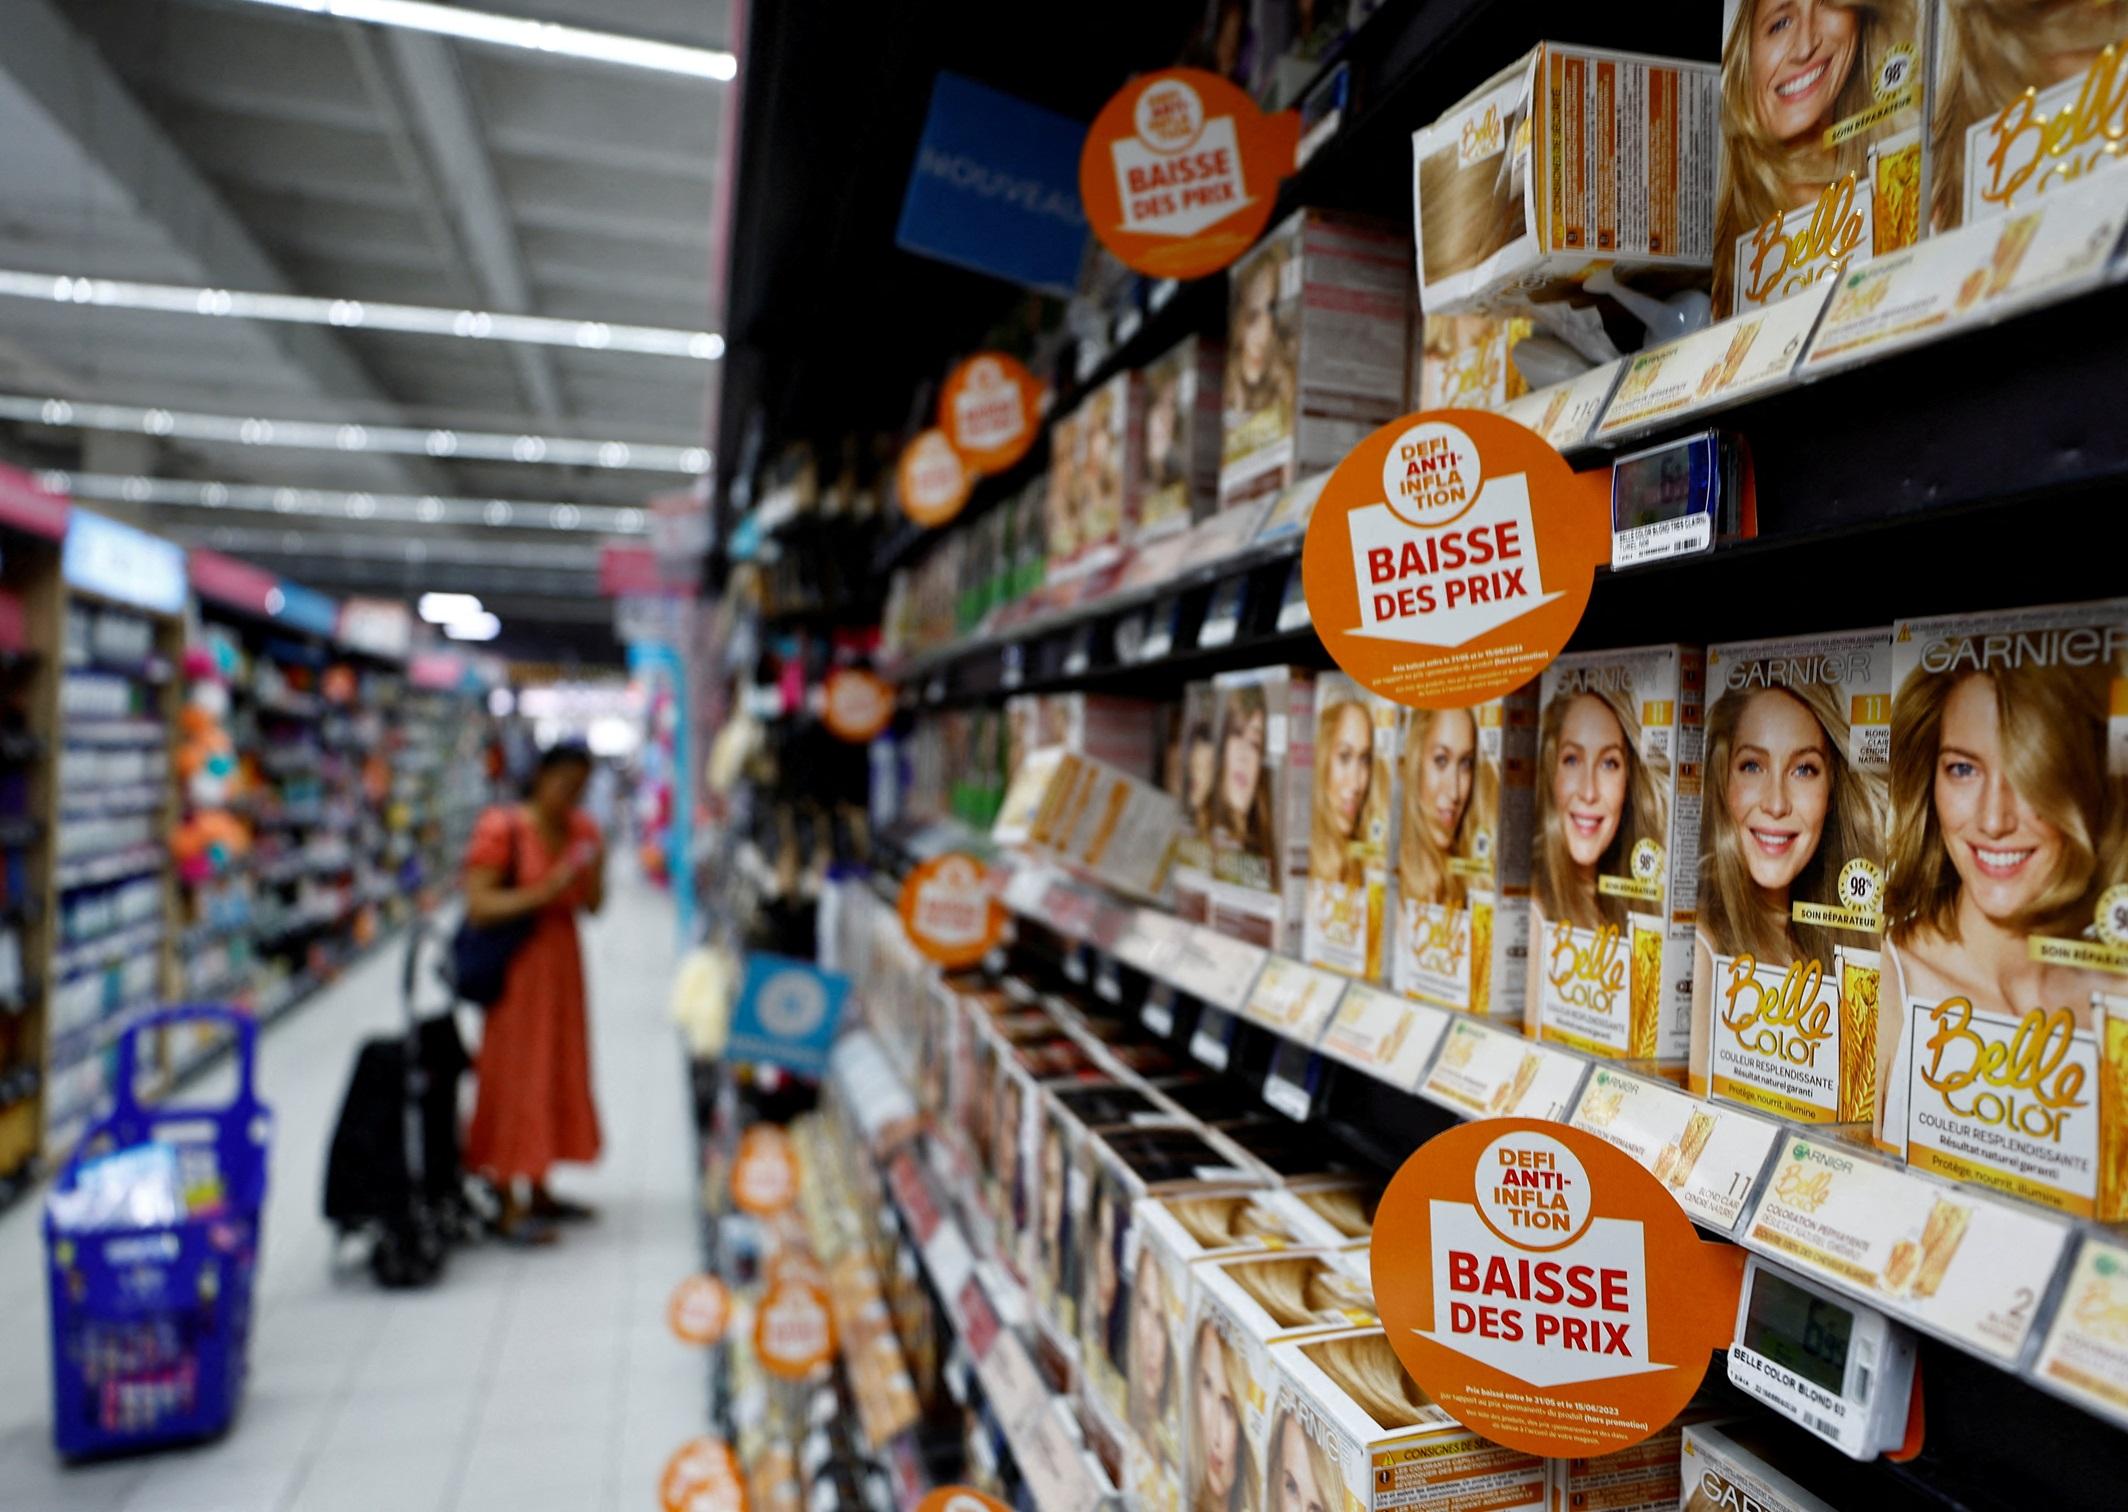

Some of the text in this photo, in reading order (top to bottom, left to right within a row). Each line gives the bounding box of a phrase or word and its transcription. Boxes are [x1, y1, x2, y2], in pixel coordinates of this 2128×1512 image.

[1831, 96, 1913, 143] SOIN RÉPARATEUR
[1981, 34, 2128, 211] Bell
[1128, 148, 1231, 194] BAISSE
[1133, 182, 1236, 221] DES PRIX
[1744, 169, 1868, 302] Belle
[1401, 436, 1448, 461] DEFI
[1407, 451, 1463, 476] ANTI-
[1400, 470, 1462, 495] INFLA
[1413, 486, 1466, 510] TION
[1368, 520, 1521, 585] BAISSE
[1373, 566, 1528, 622] DES PRIX
[1726, 652, 1872, 690] GARNIER
[1867, 697, 1881, 721] 11
[1865, 729, 1889, 739] BLOND
[1850, 876, 1873, 897] 98%
[1801, 909, 1877, 929] SOIN RÉPARATEUR
[1549, 918, 1626, 993] Belle
[1721, 952, 1834, 1040] Belle
[1920, 995, 2089, 1109] Belle
[1720, 1049, 1834, 1091] COULEUR RESPLENDISSANTE
[1733, 1066, 1813, 1098] Résultat naturel garanti
[1728, 1083, 1817, 1119] Protège, nourrit, illumine
[1918, 1111, 2089, 1172] COULEUR RESPLENDISSANTE
[1940, 1134, 2060, 1181] Résultat naturel garanti
[1499, 1148, 1555, 1169] DEFI
[1793, 1142, 1854, 1175] GARNIER
[1932, 1154, 1973, 1179] Protège,
[1502, 1168, 1572, 1191] ANTI-
[1728, 1172, 1752, 1200] 11
[1494, 1187, 1569, 1211] INFLA
[1699, 1187, 1741, 1209] BLOND CLAIR
[1708, 1201, 1735, 1219] NATUREL
[1508, 1208, 1571, 1232] TION
[1766, 1203, 1871, 1252] COLORATION PERMANENTE
[1448, 1250, 1630, 1313] BAISSE
[2009, 1287, 2034, 1318] 2
[1450, 1301, 1633, 1358] DES PRIX
[1734, 1347, 1762, 1371] BELLE
[1764, 1364, 1796, 1389] COLOR
[1798, 1383, 1833, 1410] BLOND
[1465, 1385, 1480, 1395] Prix
[1505, 1392, 1524, 1402] entre
[1525, 1394, 1533, 1403] le
[1556, 1400, 1565, 1409] et
[1566, 1401, 1574, 1409] le
[1487, 1399, 1501, 1410] prix
[1548, 1407, 1557, 1417] du
[1558, 1408, 1583, 1421] produit
[1584, 1414, 1604, 1426] (hors
[1605, 1417, 1648, 1432] promotion)
[1404, 1442, 1461, 1461] CONSIGNES
